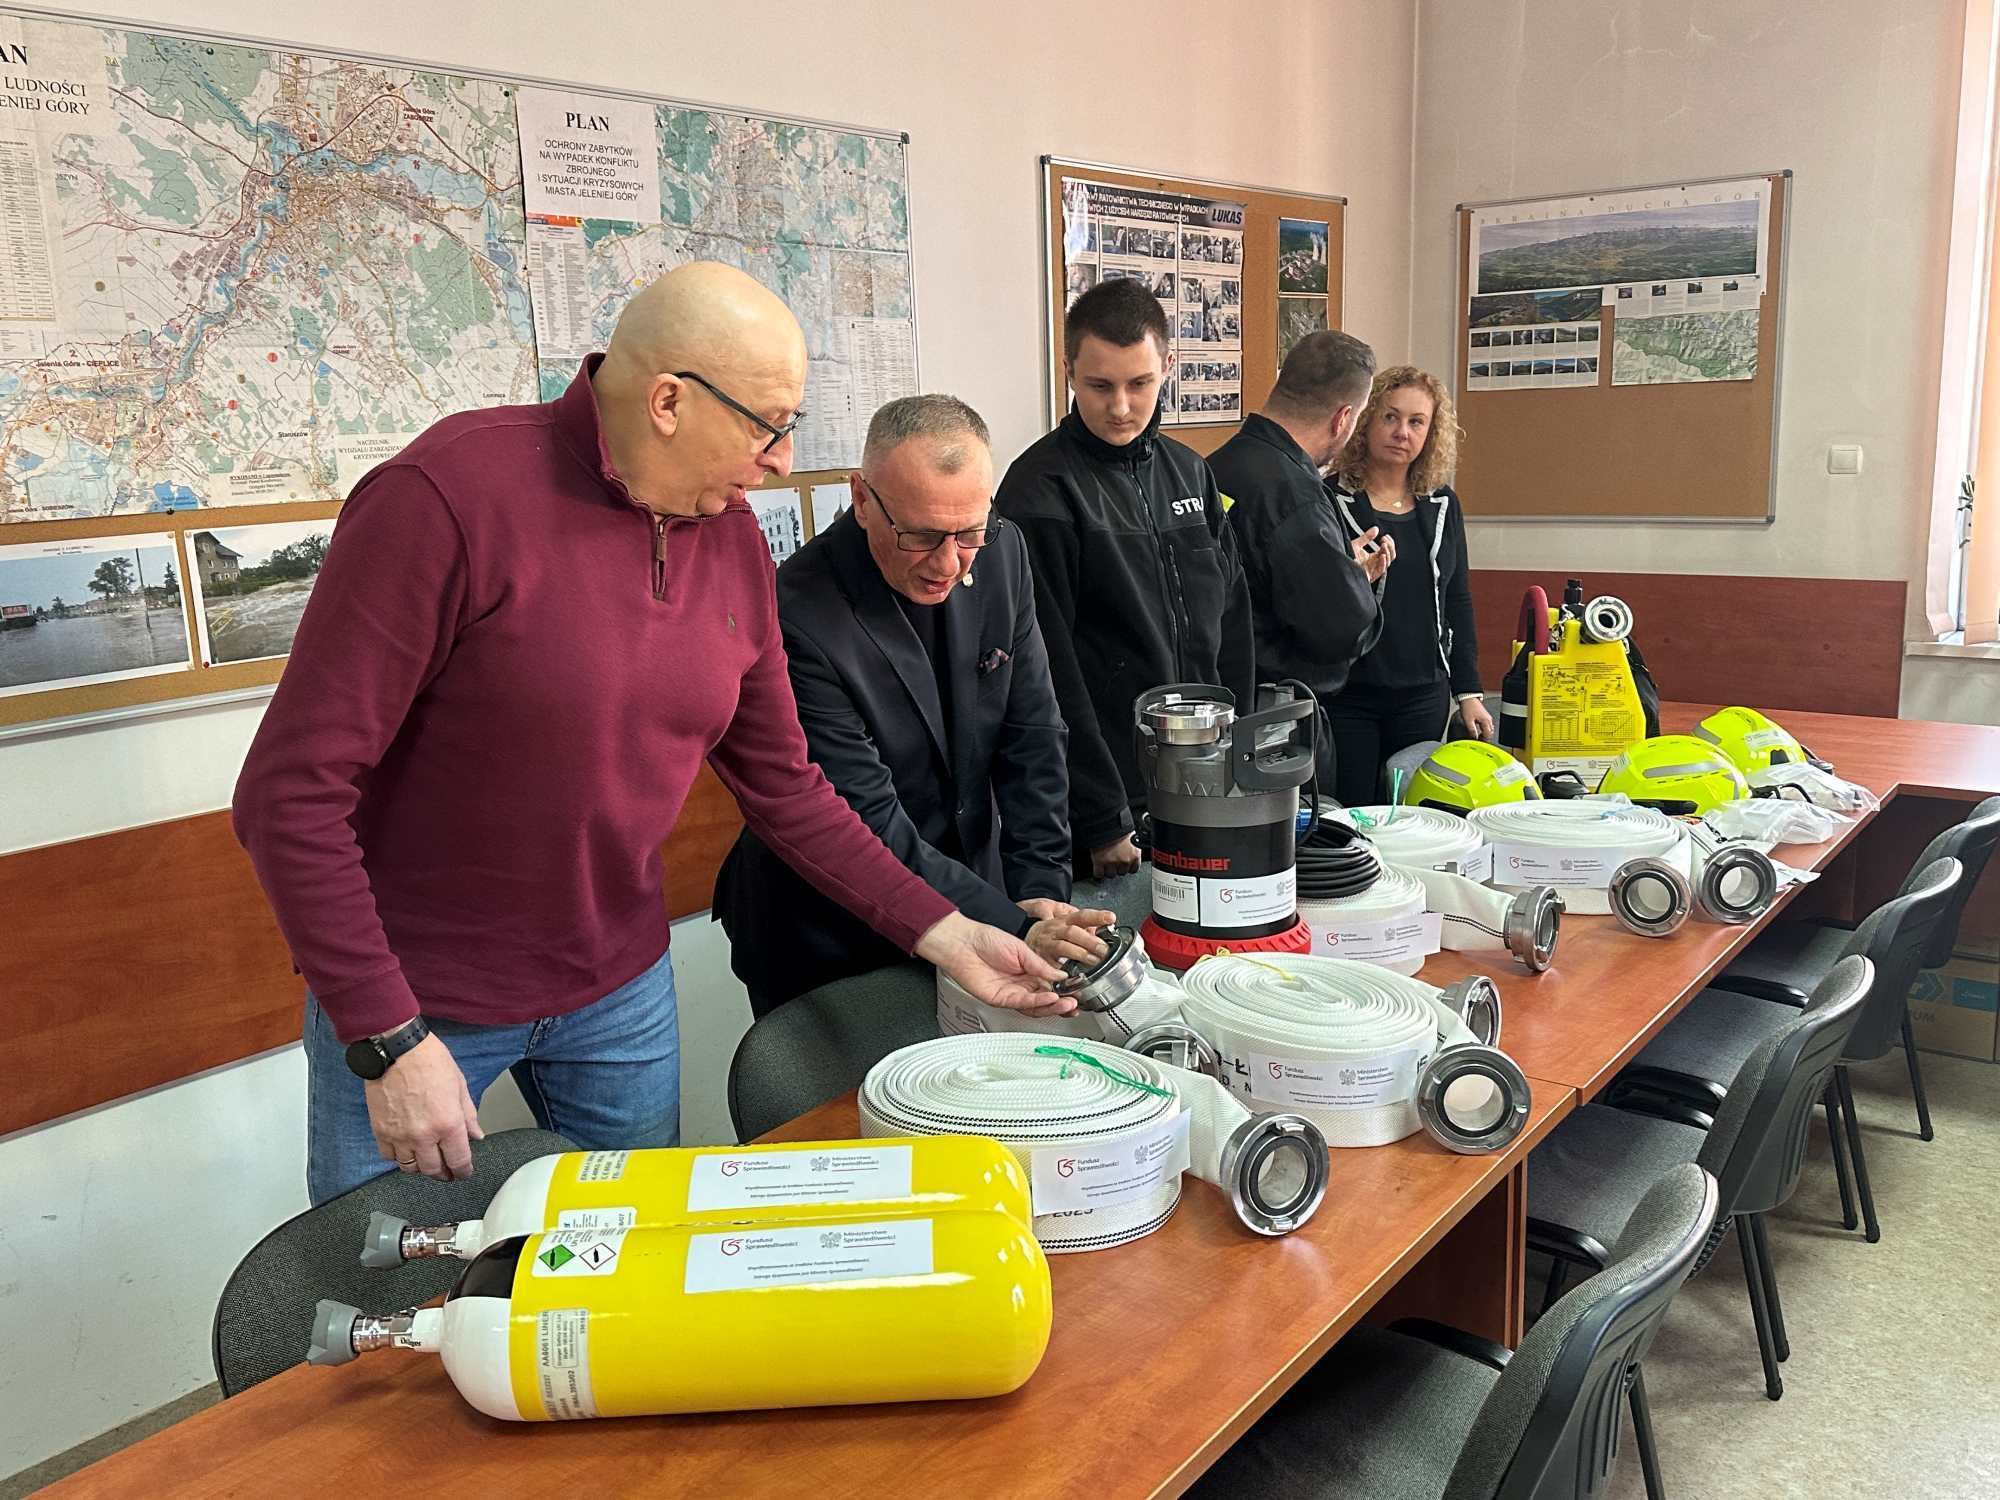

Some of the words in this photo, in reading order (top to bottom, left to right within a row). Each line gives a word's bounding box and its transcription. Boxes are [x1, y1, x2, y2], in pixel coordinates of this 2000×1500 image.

[4, 76, 86, 97] LUDNOŚCI
[46, 97, 90, 115] GÓRY
[565, 112, 609, 132] PLAN
[544, 139, 587, 151] OCHRONY
[588, 143, 633, 157] ZABYTKÓW
[539, 150, 551, 160] NA
[552, 151, 595, 164] WYPADEK
[595, 156, 639, 169] KONFLIKTU
[566, 164, 616, 177] ZBROJNEGO
[541, 174, 581, 186] SYTUACJI
[583, 177, 645, 191] KRYZYSOWYCH
[545, 186, 576, 197] MIASTA
[577, 188, 614, 200] JELENIEJ
[615, 190, 638, 201] GÓRY
[1212, 208, 1243, 225] LUKAS
